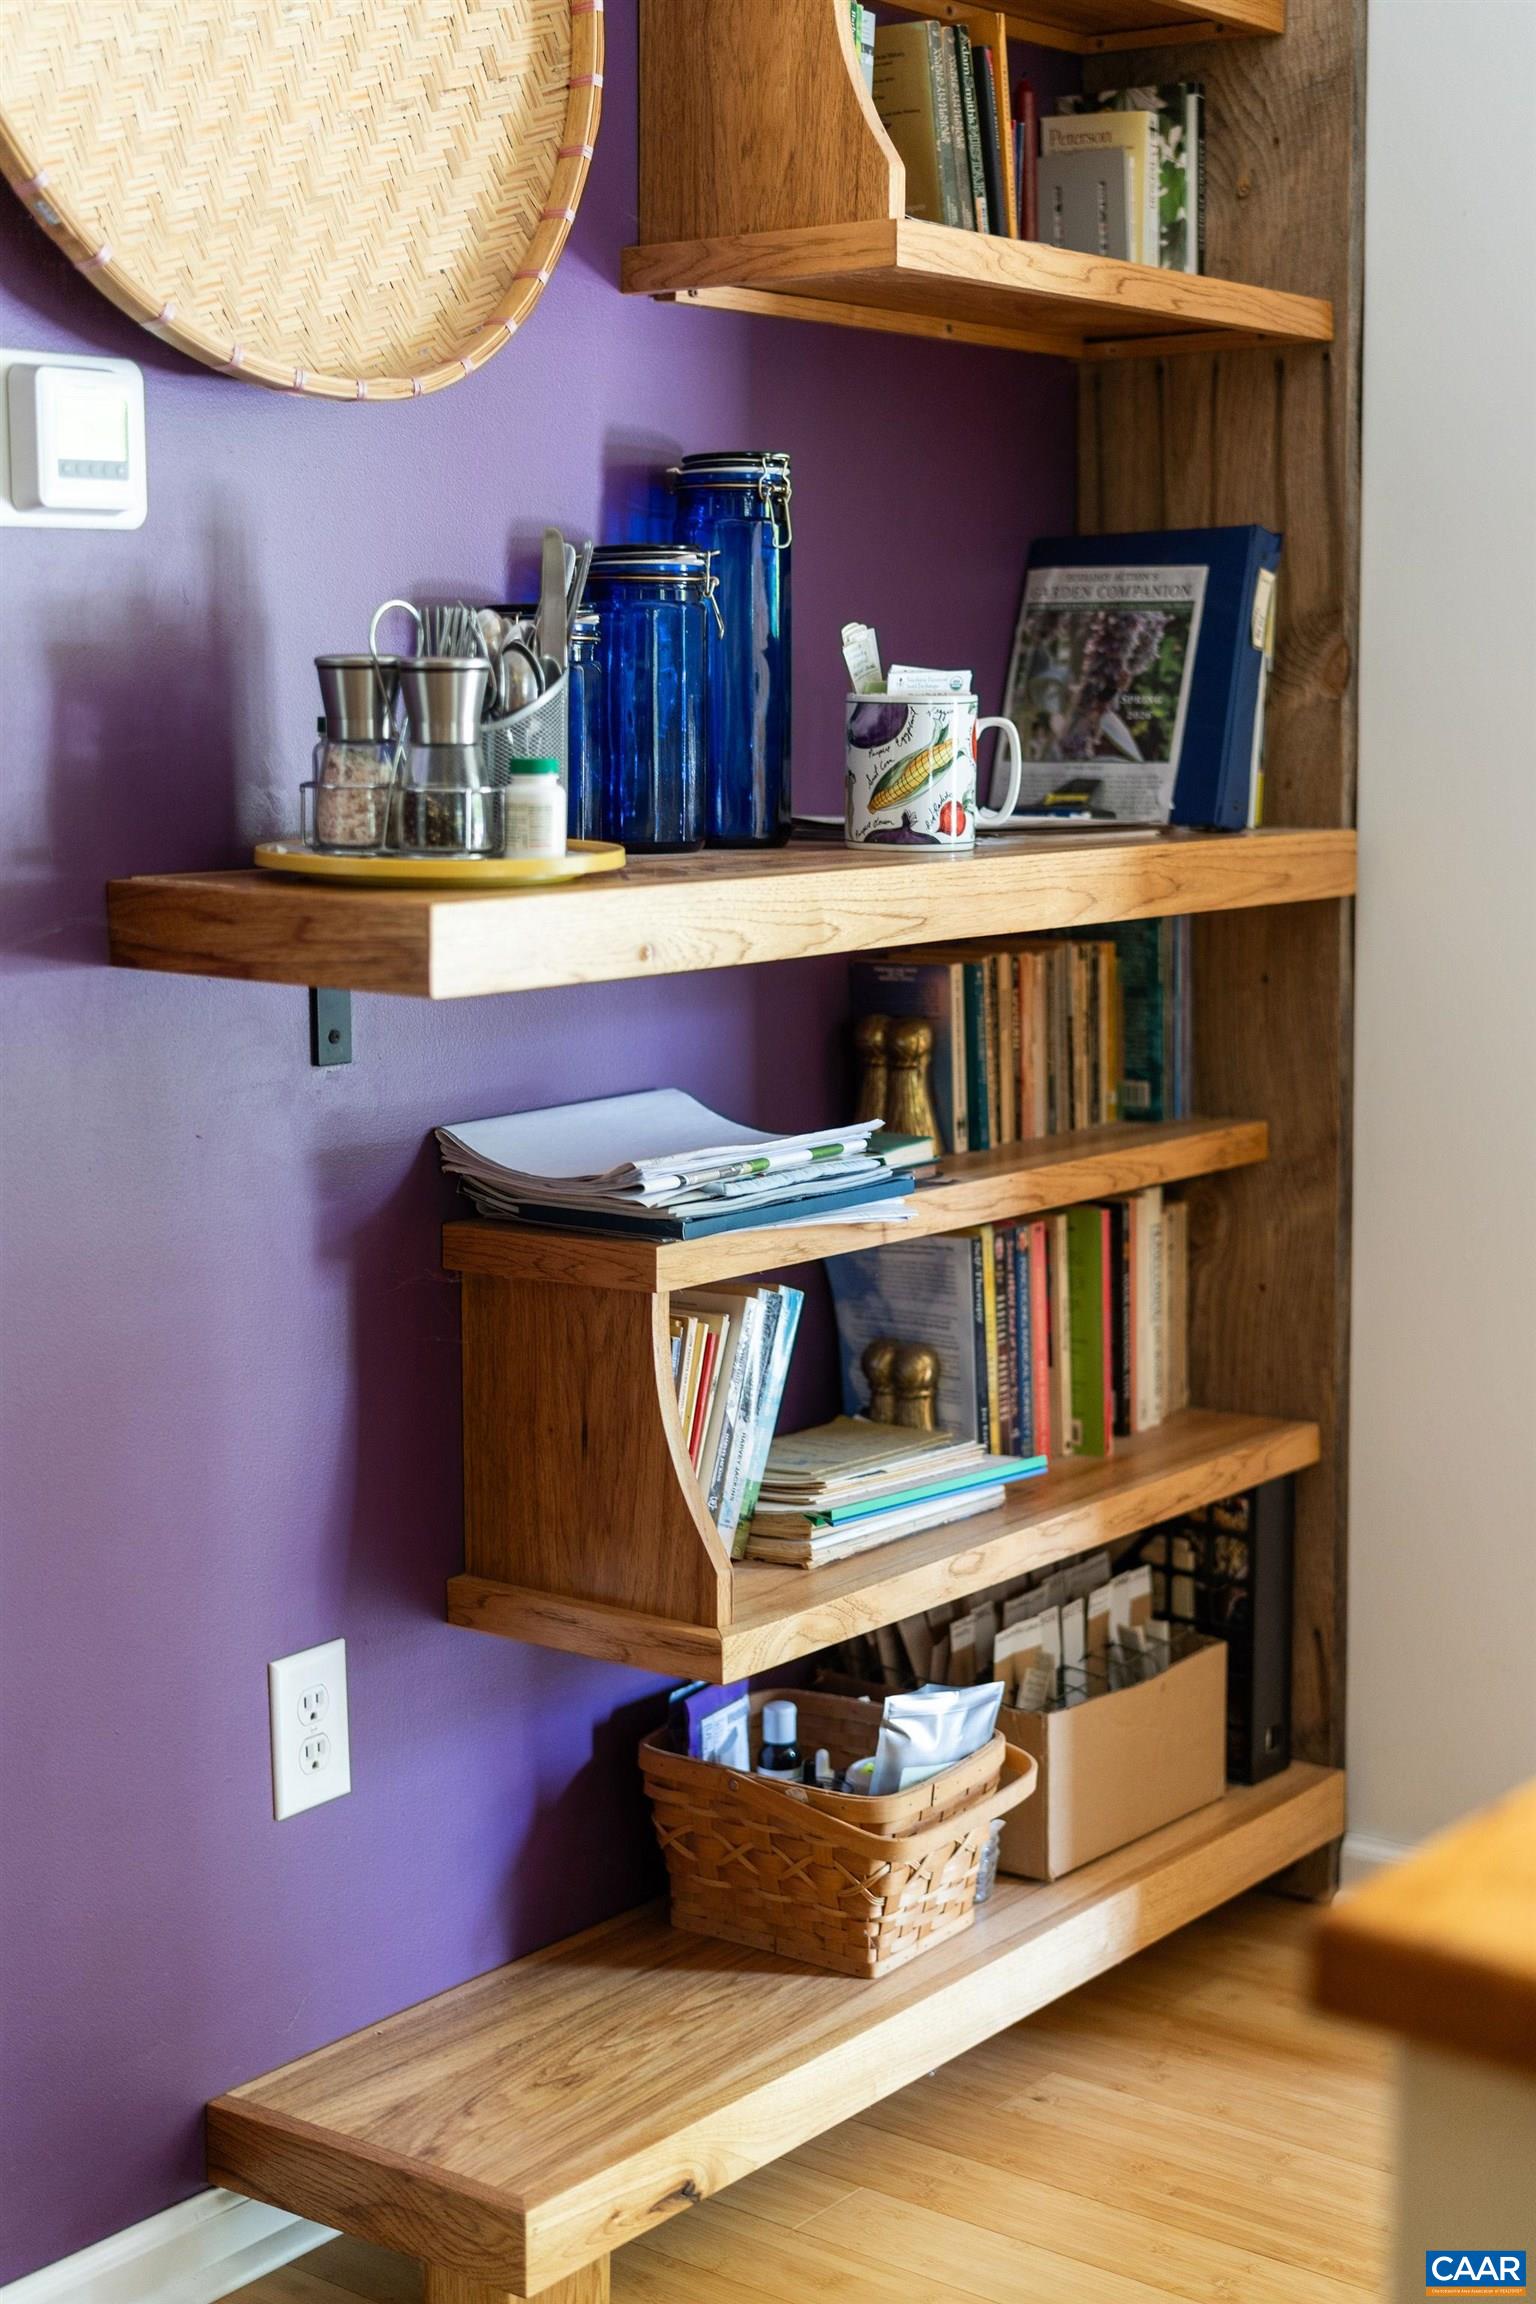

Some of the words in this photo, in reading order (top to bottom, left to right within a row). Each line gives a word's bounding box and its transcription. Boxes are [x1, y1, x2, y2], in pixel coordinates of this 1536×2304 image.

[959, 32, 971, 75] Adam
[1049, 129, 1113, 145] Peterson
[1096, 584, 1193, 599] COMPANION
[895, 706, 918, 748] Eggplant
[736, 1432, 747, 1464] HARVEY
[729, 1467, 741, 1501] JACKINS
